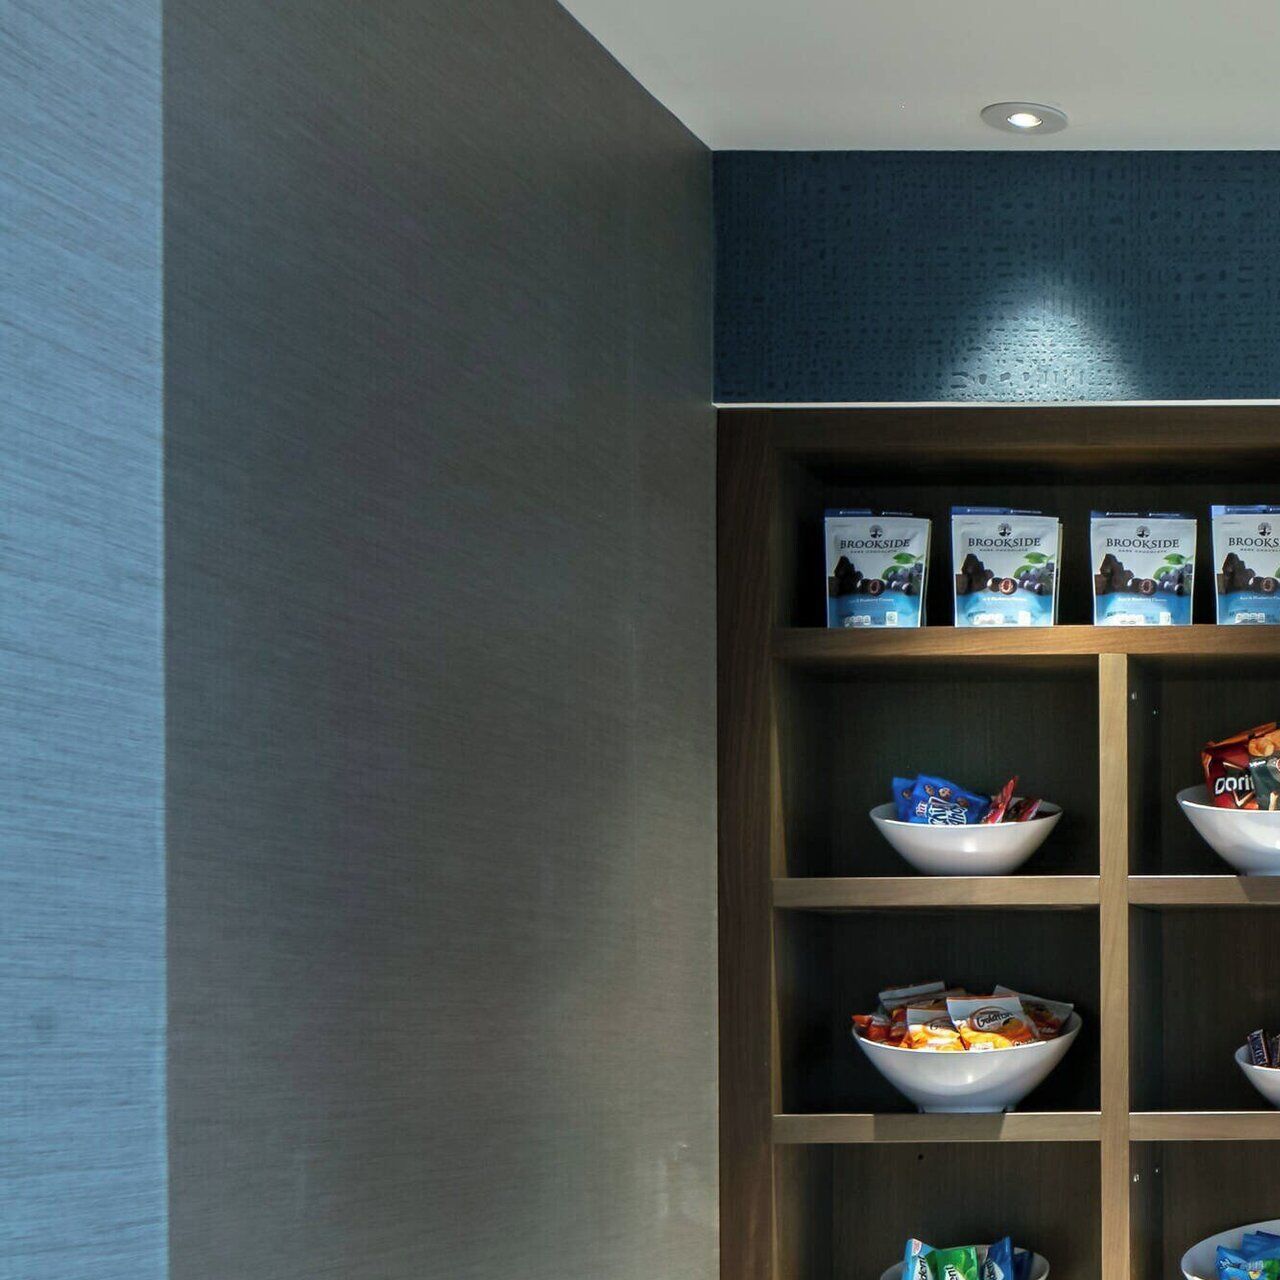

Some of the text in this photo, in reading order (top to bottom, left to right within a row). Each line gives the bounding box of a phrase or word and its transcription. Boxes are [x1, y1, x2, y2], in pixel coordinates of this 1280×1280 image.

[840, 538, 911, 549] BROOKSIDE
[968, 537, 1041, 548] BROOKSIDE
[1106, 538, 1180, 549] BROOKSIDE
